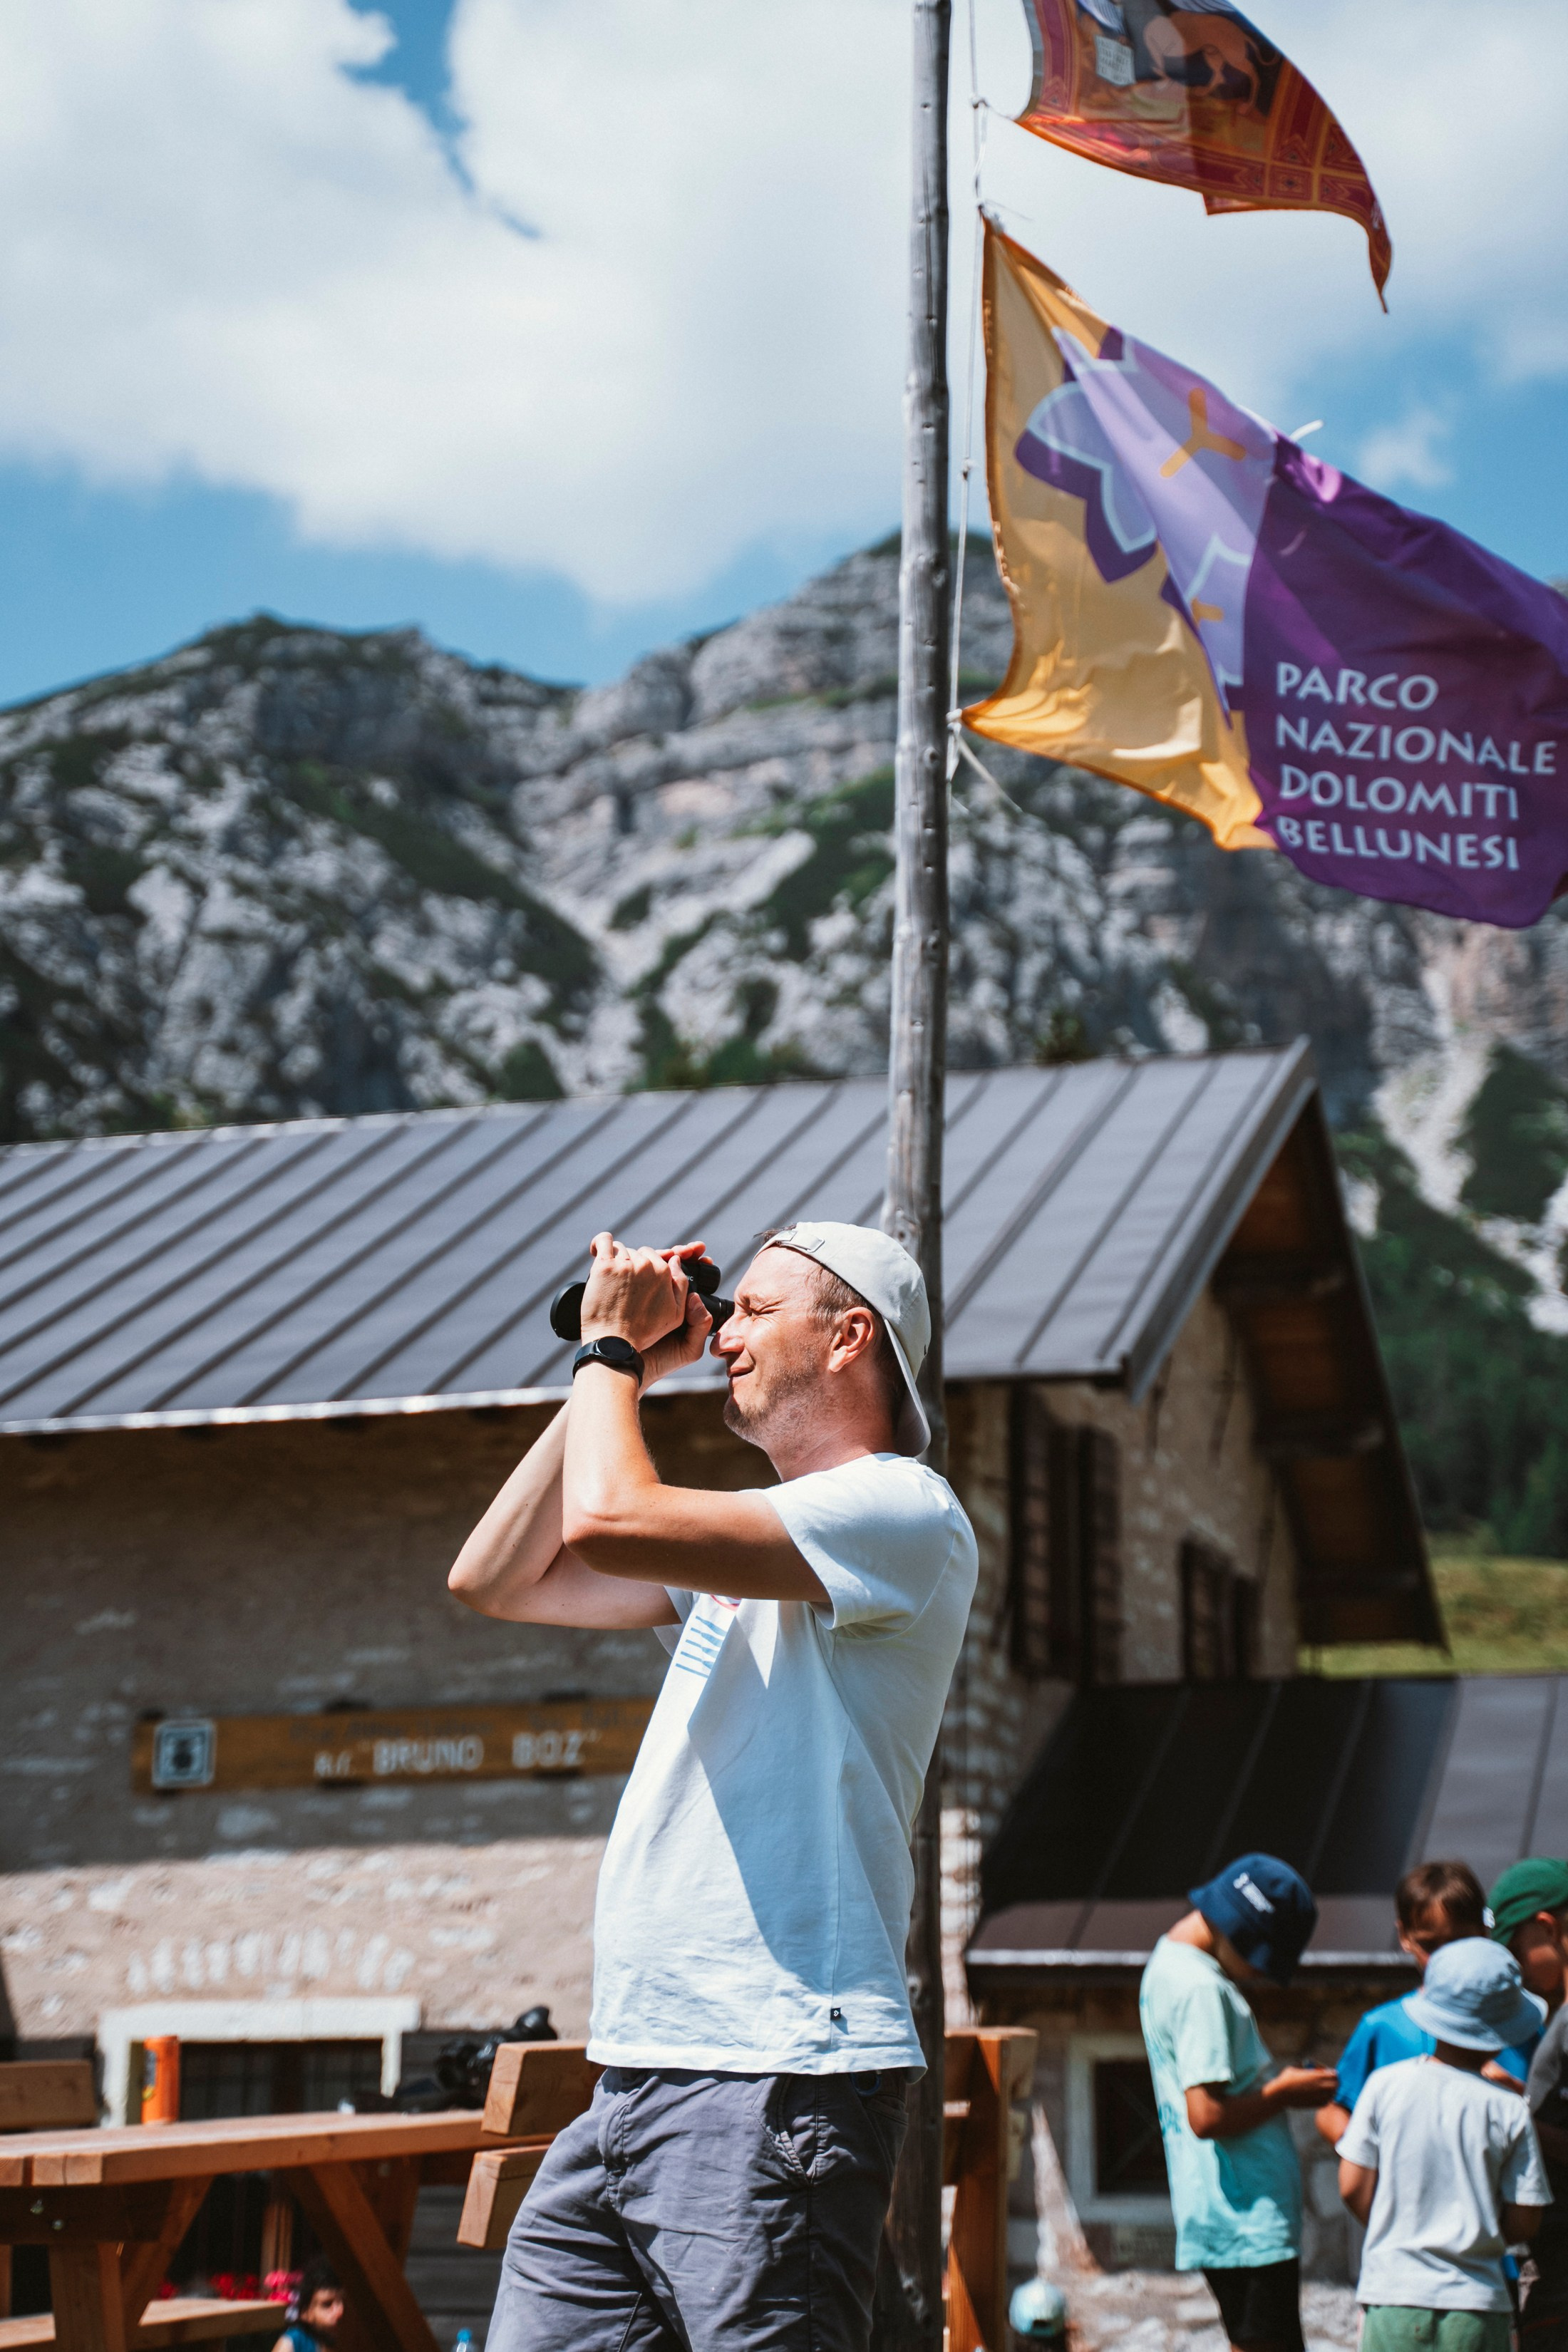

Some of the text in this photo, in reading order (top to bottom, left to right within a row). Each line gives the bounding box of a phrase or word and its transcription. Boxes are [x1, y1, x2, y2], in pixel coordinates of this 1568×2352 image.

[1276, 661, 1439, 711] PARCO
[1276, 714, 1557, 775] NAZIONALE
[1279, 763, 1519, 820] DOLOMITI
[1276, 815, 1520, 870] BELLUNESI
